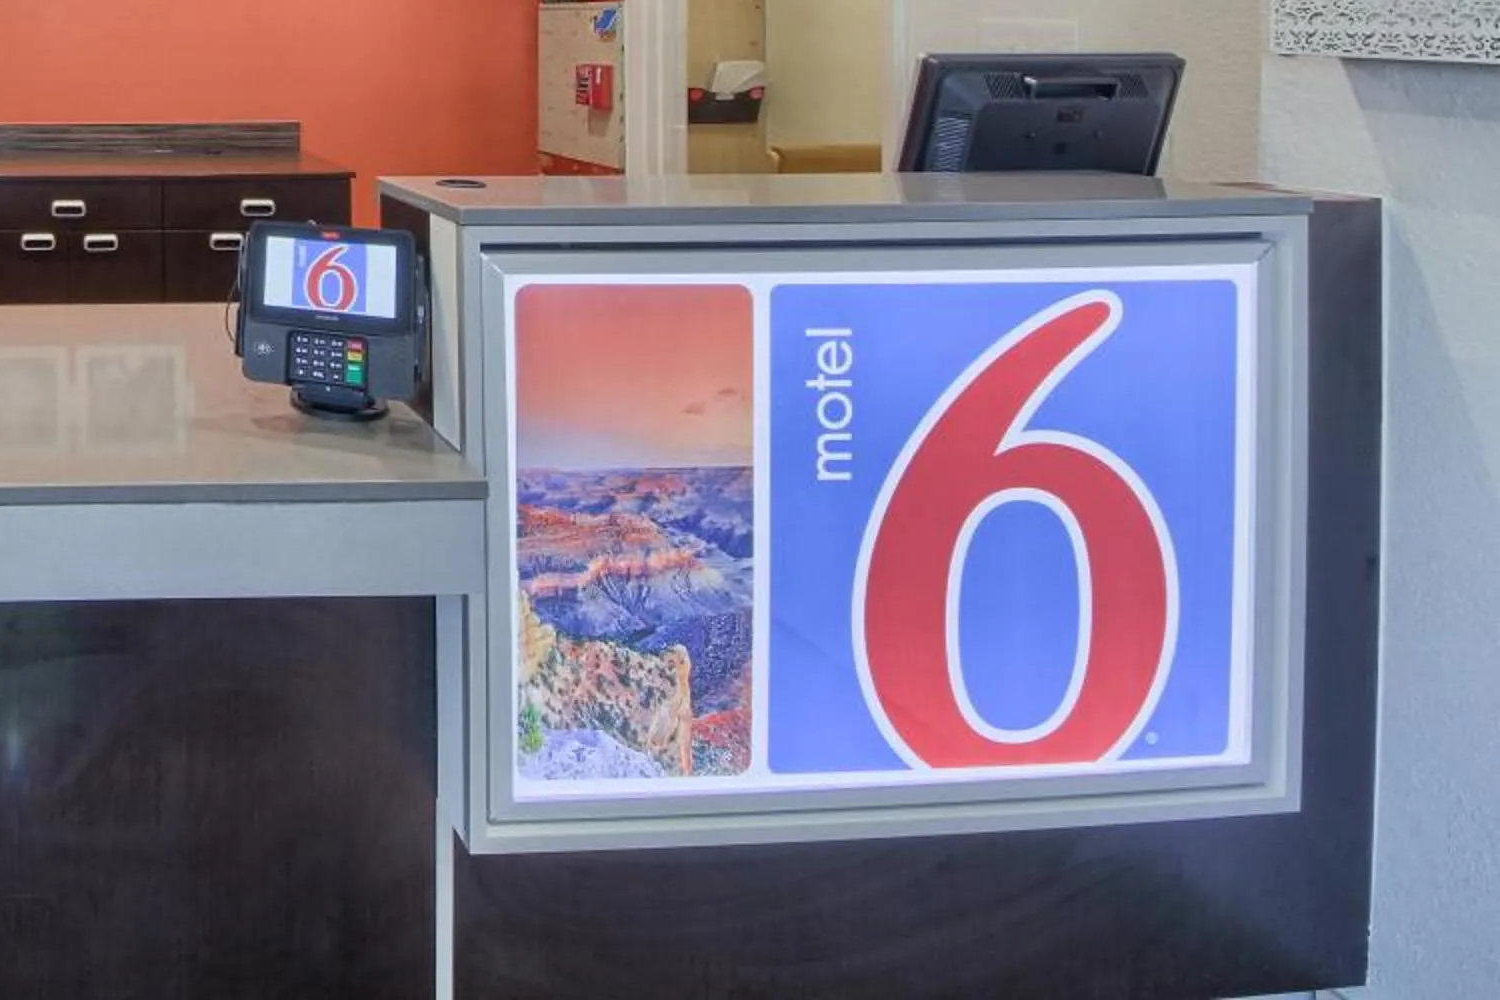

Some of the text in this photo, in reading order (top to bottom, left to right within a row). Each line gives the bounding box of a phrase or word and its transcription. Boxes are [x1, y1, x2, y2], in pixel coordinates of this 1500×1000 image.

[303, 243, 358, 312] 6
[805, 288, 1180, 769] motel 6
